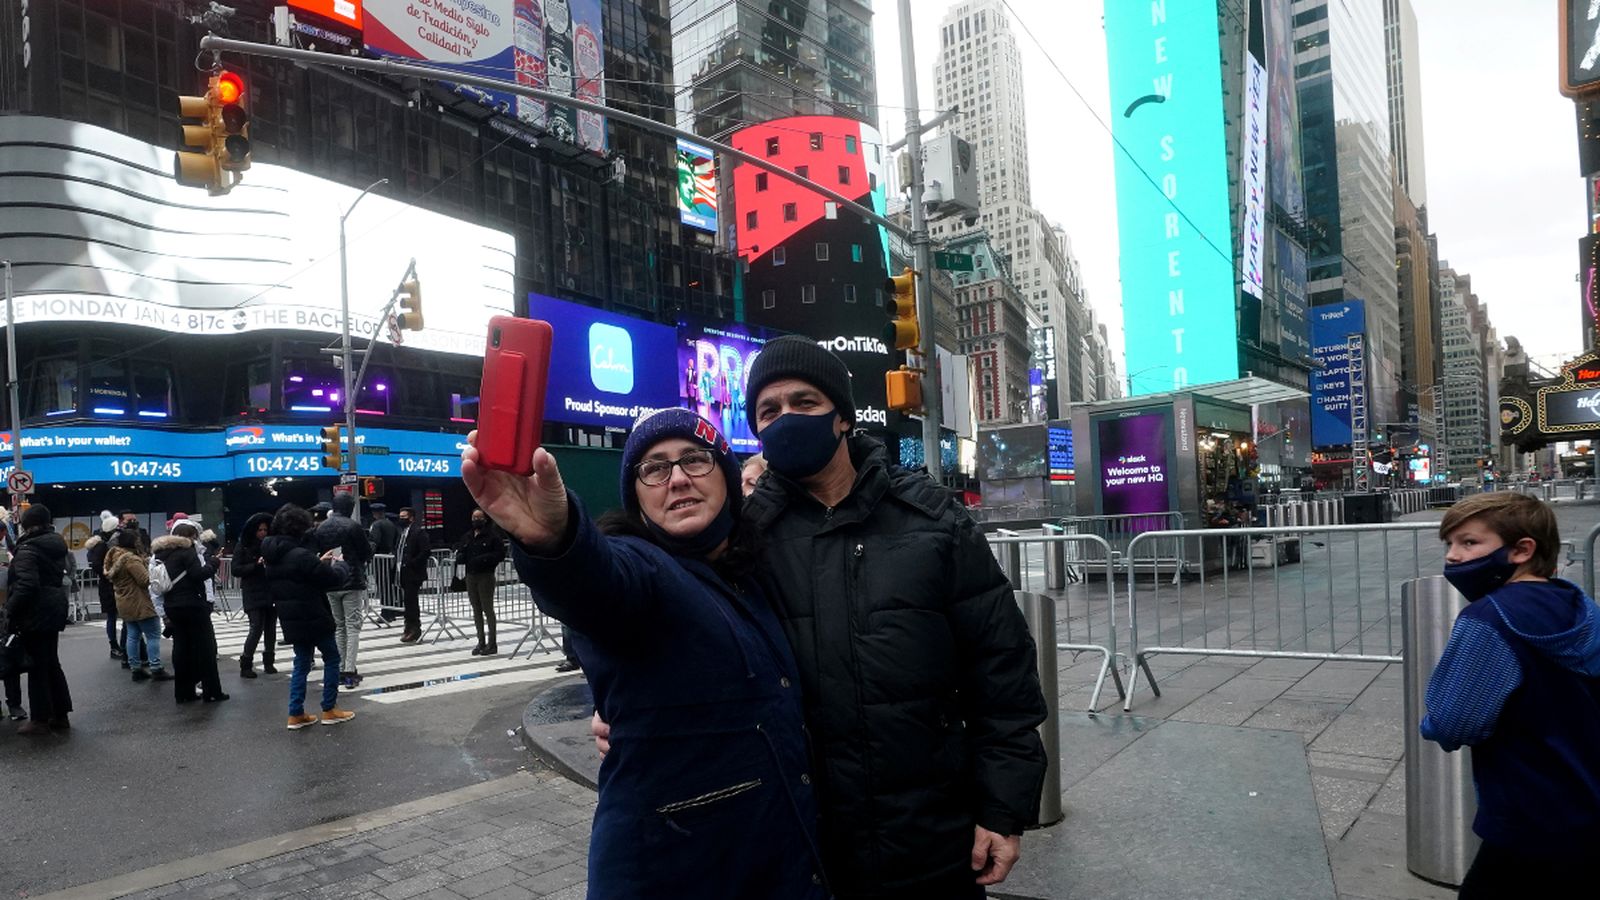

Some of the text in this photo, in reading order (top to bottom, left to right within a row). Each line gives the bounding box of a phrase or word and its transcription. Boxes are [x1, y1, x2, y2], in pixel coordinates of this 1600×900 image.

[406, 3, 479, 49] de Tradición y
[433, 0, 464, 23] Medio
[465, 16, 490, 37] Siglo
[32, 299, 127, 318] MONDAY
[134, 305, 165, 325] JAN
[171, 313, 181, 327] 4
[252, 309, 288, 325] THE
[591, 344, 631, 373] Calm
[1327, 353, 1352, 362] WOR
[1323, 381, 1345, 390] KEYS
[565, 397, 593, 413] Proud
[594, 401, 629, 417] Sponsor
[629, 405, 639, 417] of
[1324, 403, 1348, 411] SUIT?
[20, 436, 53, 447] What's
[55, 435, 66, 446] in
[67, 437, 92, 449] your
[95, 436, 131, 446] wallet?
[272, 433, 304, 443] What's
[305, 433, 315, 443] in
[110, 460, 182, 477] 10:47:45
[247, 456, 320, 472] 10:47:45
[398, 458, 450, 472] 10:47:45
[1107, 465, 1160, 476] Welcome to
[1105, 473, 1164, 487] your new HQ
